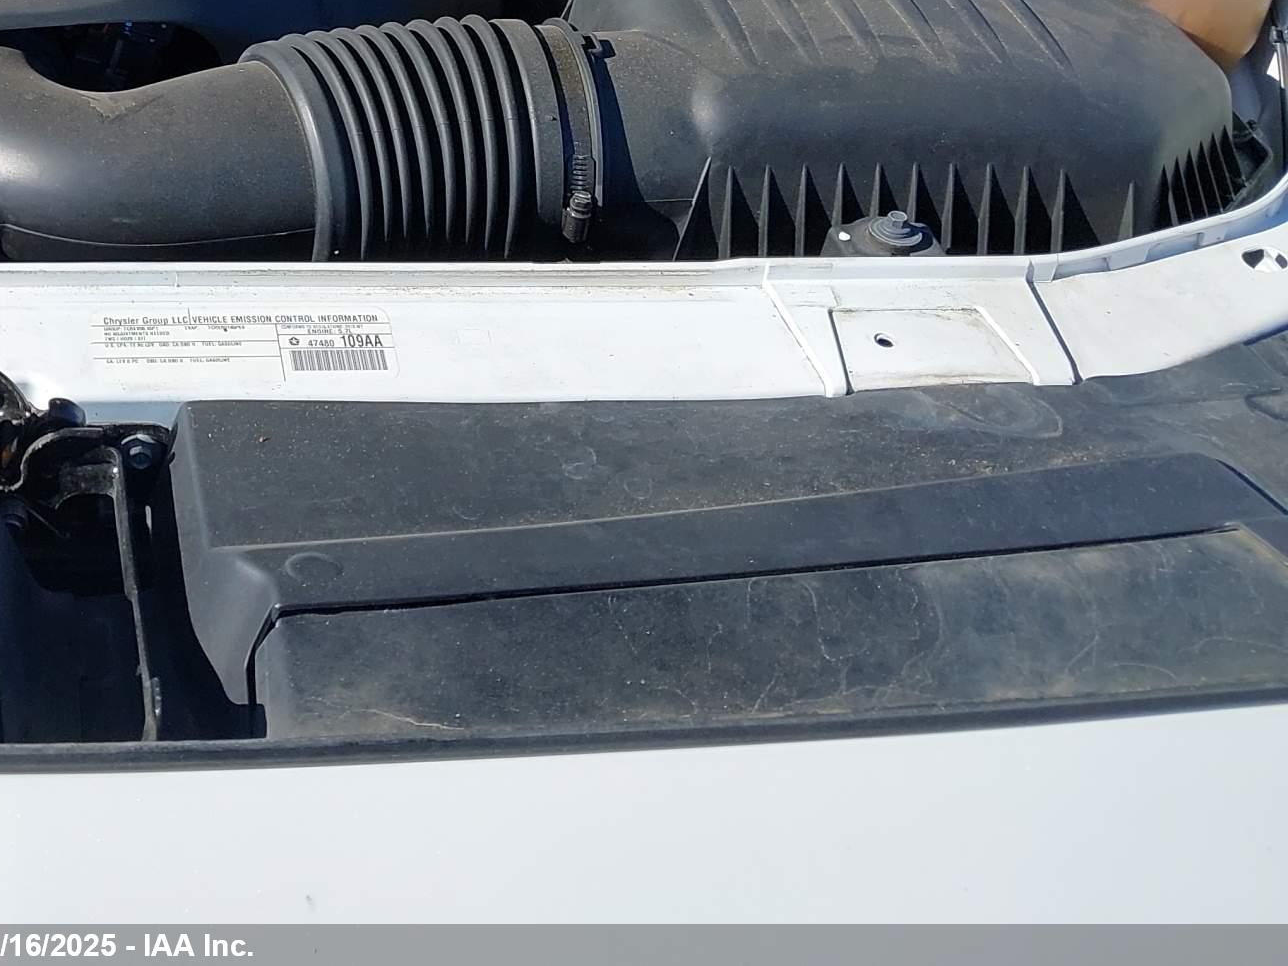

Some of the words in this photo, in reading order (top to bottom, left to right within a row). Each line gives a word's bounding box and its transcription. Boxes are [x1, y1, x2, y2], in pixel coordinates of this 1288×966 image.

[103, 316, 139, 326] Chrysler
[142, 316, 168, 326] Group
[172, 316, 188, 324] LLC
[192, 316, 227, 324] VEHICLE
[230, 315, 272, 324] EMISSION
[275, 315, 314, 323] CONTROL
[318, 314, 378, 322] INFORMATION
[340, 334, 383, 348] 109AA
